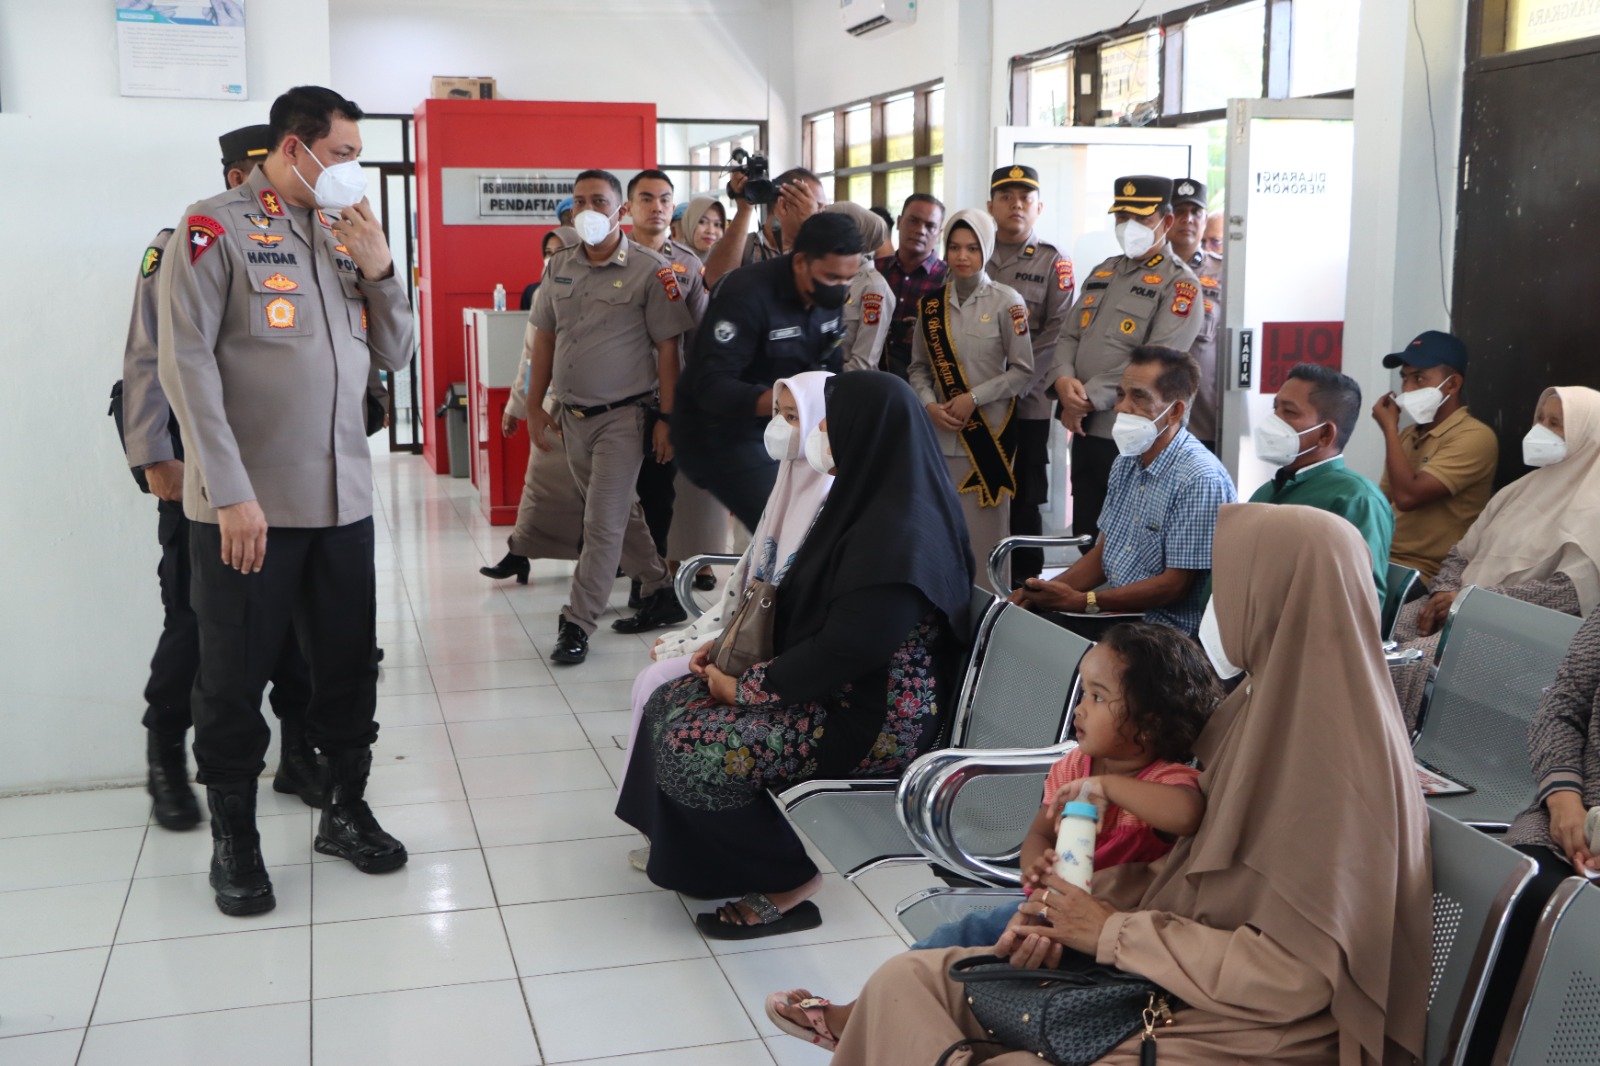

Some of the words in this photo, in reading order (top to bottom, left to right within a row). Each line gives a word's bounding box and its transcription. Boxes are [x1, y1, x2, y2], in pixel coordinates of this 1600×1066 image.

[483, 183, 494, 194] RS
[495, 183, 555, 194] BHAYANGKARA
[247, 251, 297, 265] HAYDAR
[1015, 272, 1045, 284] POLRI
[1130, 286, 1157, 299] POLRI
[1241, 334, 1250, 382] TARIK
